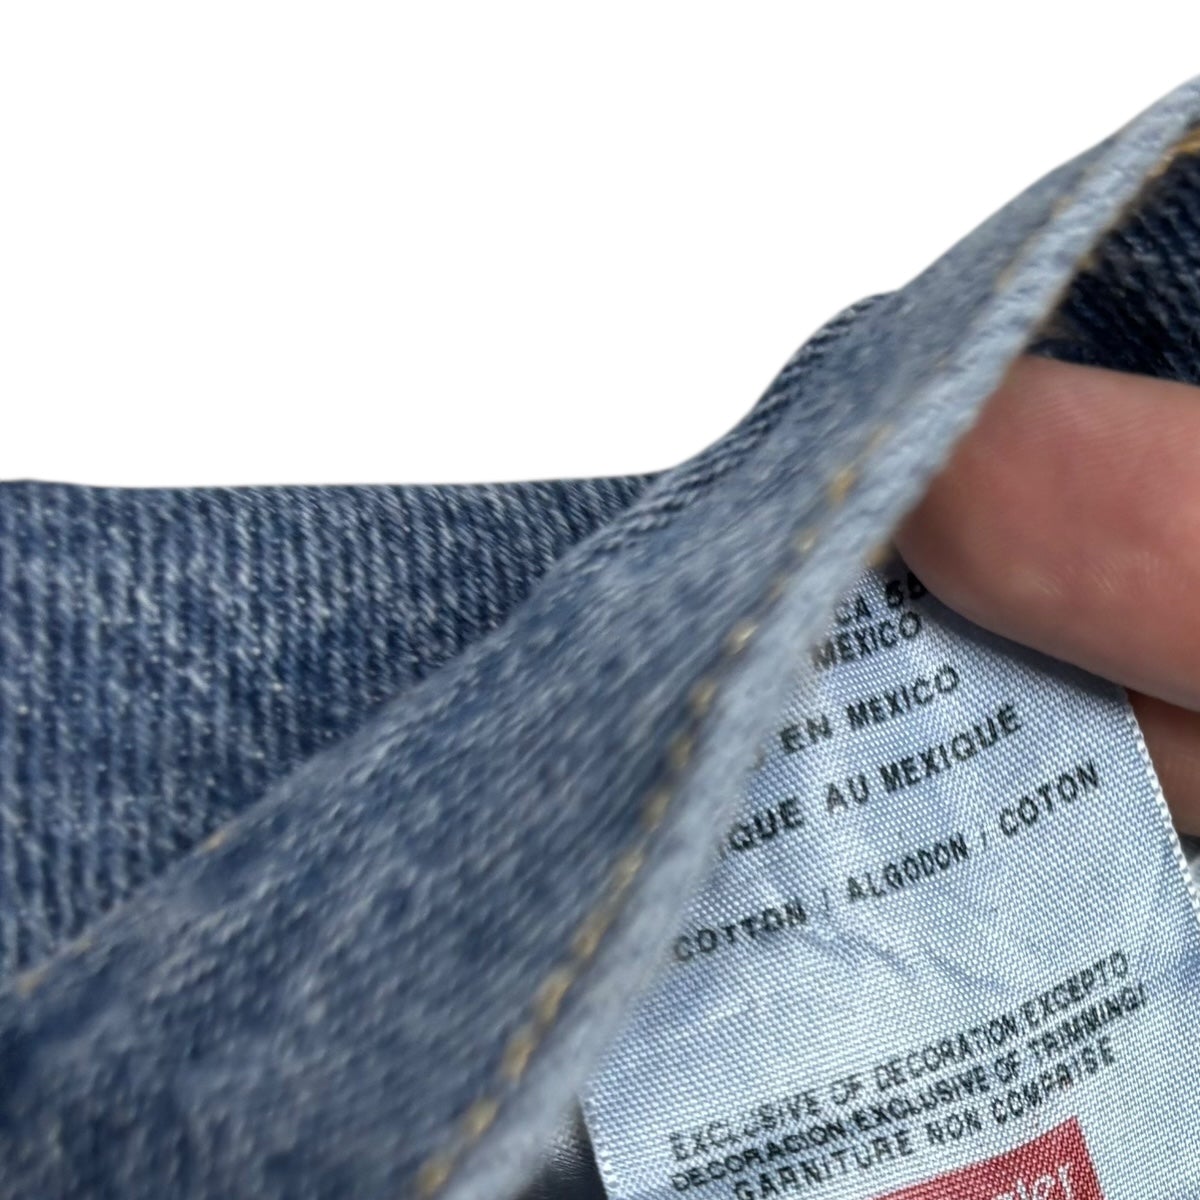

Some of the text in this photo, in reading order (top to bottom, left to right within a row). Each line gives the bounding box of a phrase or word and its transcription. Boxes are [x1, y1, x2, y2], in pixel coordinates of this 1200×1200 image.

[812, 611, 922, 671] MEXICO
[779, 664, 961, 753] EN MEXICO
[718, 702, 1021, 860] QUE AU MEXIQUE
[672, 902, 808, 963] COTTON
[847, 832, 969, 902] ALGODON
[999, 759, 1101, 837] COTON
[831, 1072, 863, 1105] OF
[926, 1106, 982, 1145] NON
[991, 1036, 1114, 1125] COMPRISE
[994, 1050, 1021, 1084] OF
